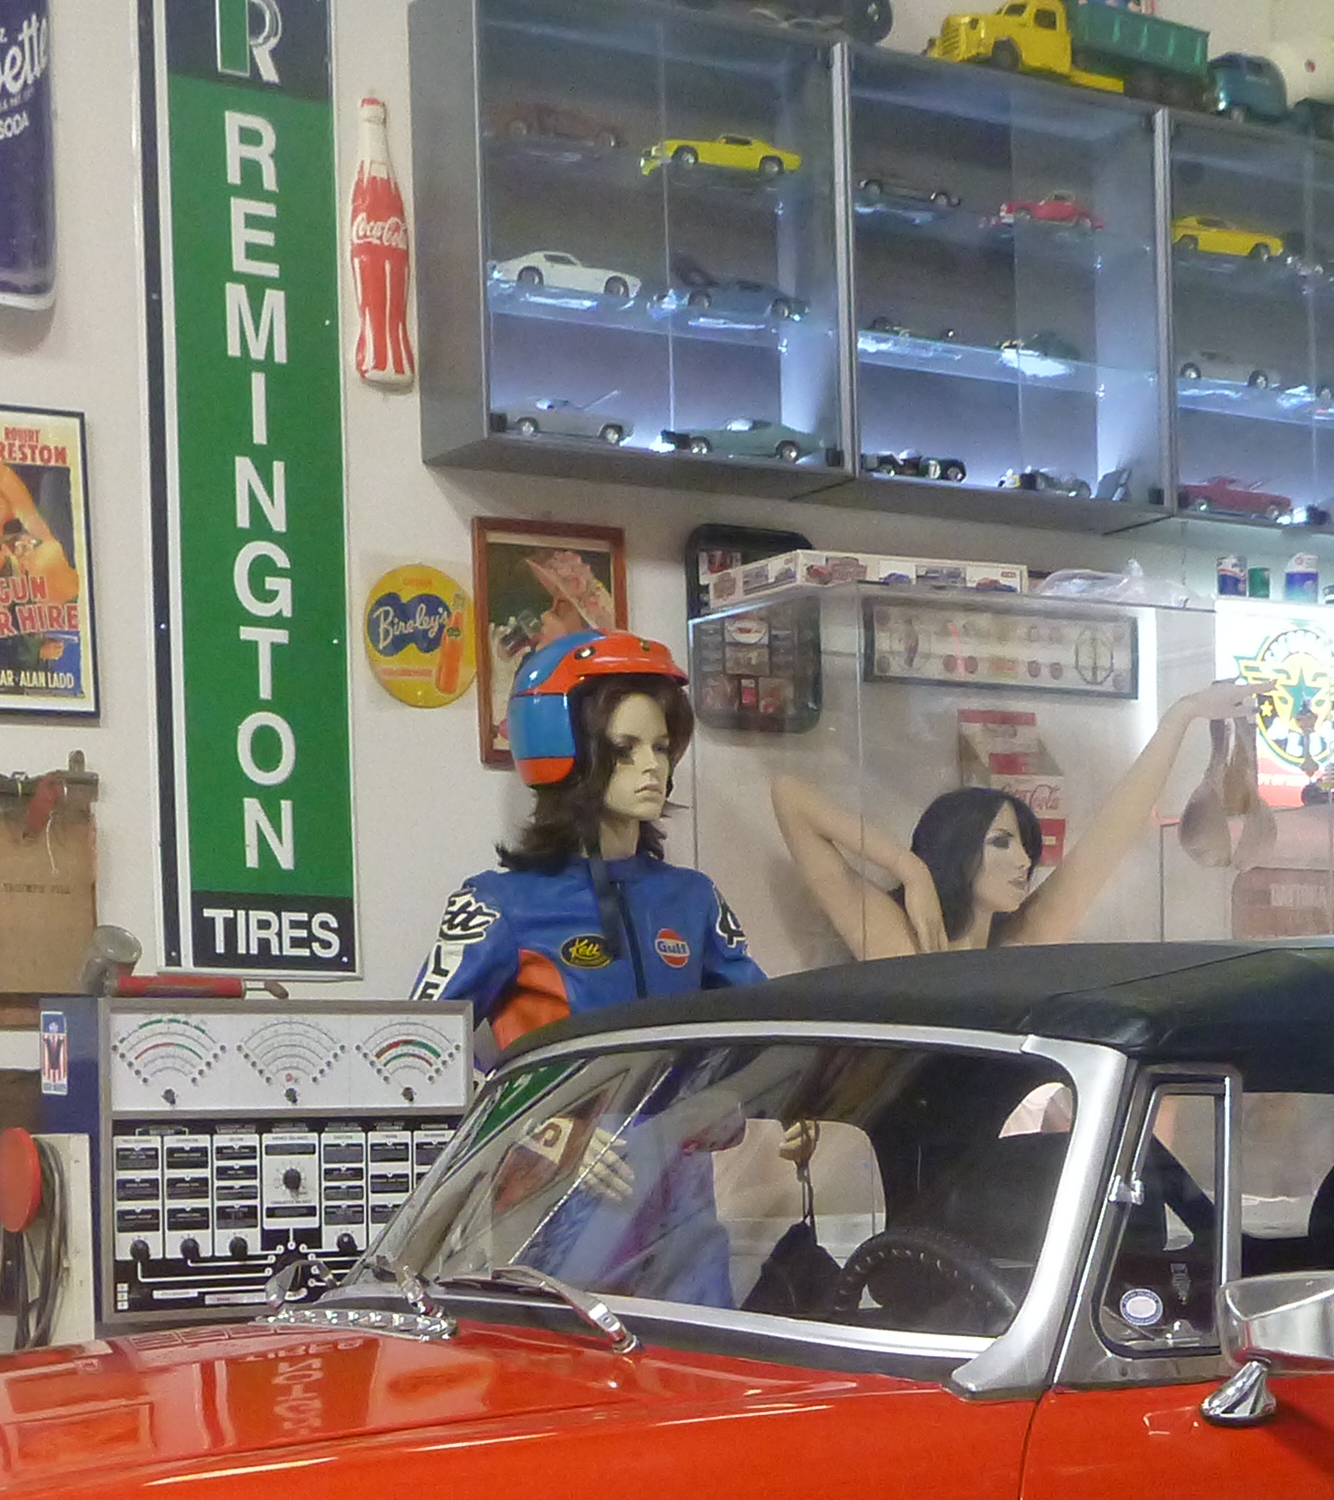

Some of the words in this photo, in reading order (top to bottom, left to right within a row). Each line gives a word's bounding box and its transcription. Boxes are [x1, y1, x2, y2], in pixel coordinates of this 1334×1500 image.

[4, 426, 42, 444] ROBERT
[225, 110, 297, 871] REMINGTON
[16, 603, 80, 633] HIRE
[19, 670, 45, 688] ALAN
[47, 672, 75, 689] LADD
[203, 908, 341, 959] TIRES
[656, 940, 688, 955] Gulf
